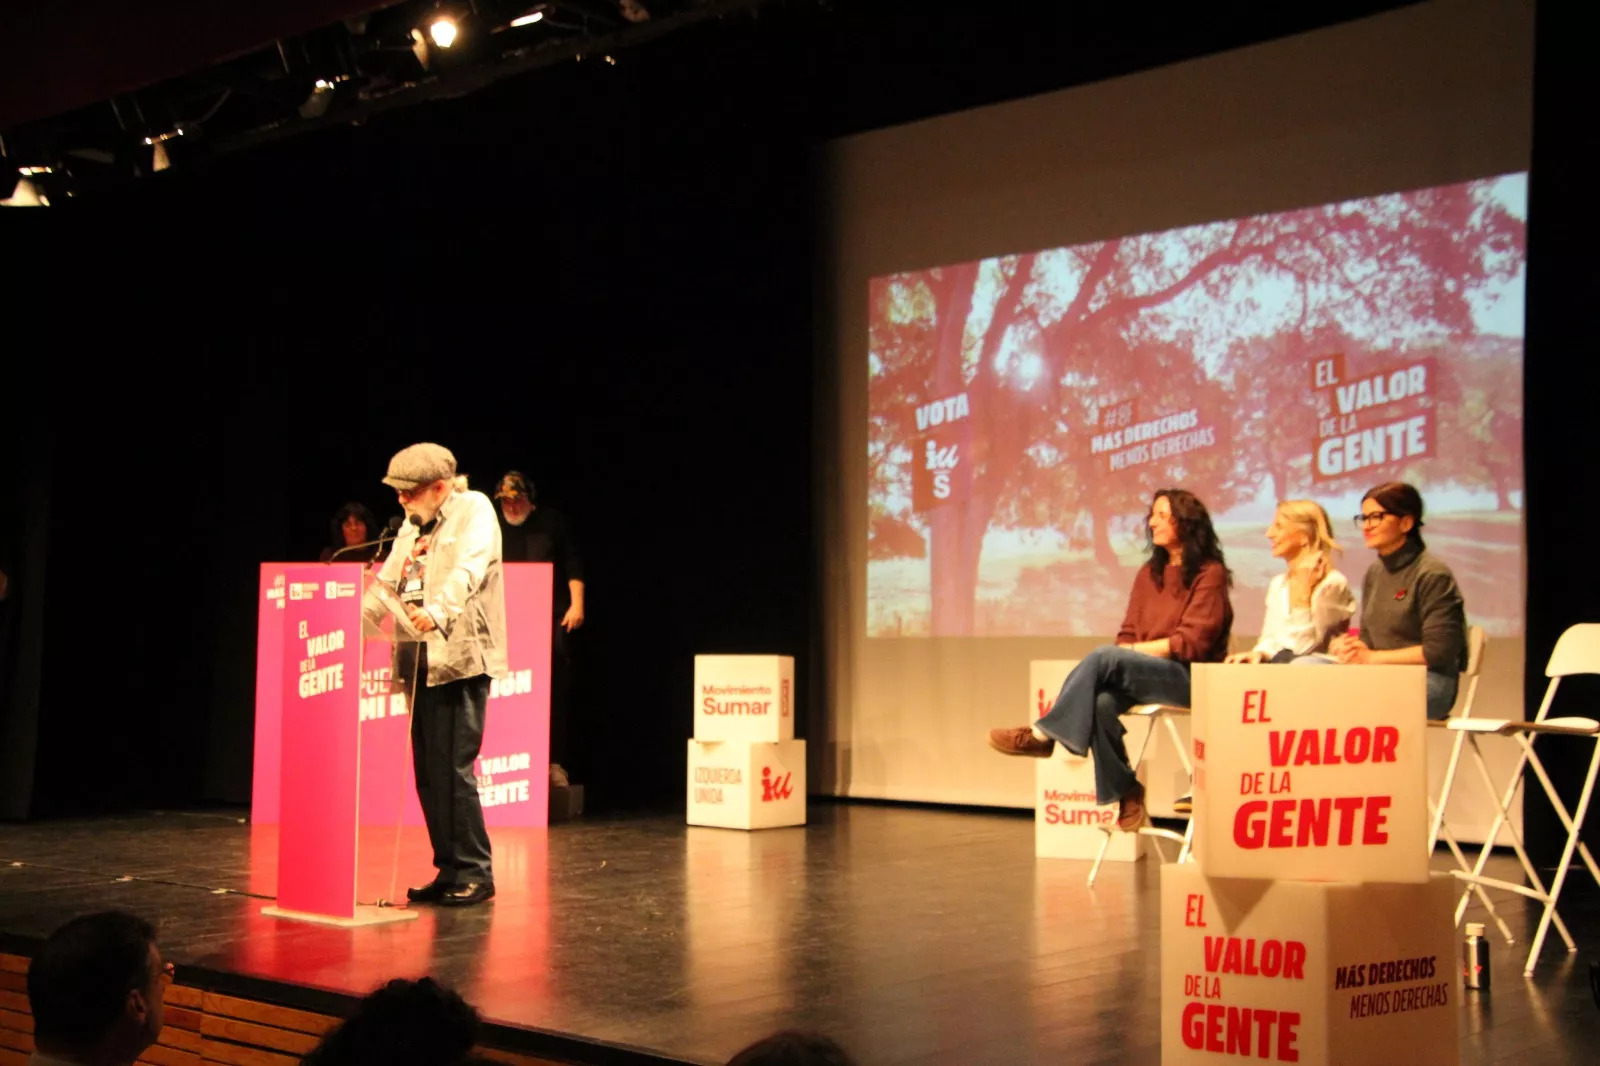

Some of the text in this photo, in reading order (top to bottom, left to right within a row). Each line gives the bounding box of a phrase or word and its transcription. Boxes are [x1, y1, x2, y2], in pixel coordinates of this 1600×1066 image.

[1315, 359, 1338, 388] EL
[1336, 364, 1426, 415] VALOR
[915, 392, 969, 430] VOTA
[1123, 408, 1198, 445] DERECHOS
[1319, 413, 1357, 438] DE LA
[1317, 415, 1426, 476] GENTE
[299, 620, 309, 639] EL
[307, 628, 345, 658] VALOR
[299, 662, 344, 699] GENTE
[702, 685, 772, 695] Movimiento
[702, 697, 772, 715] Sumar
[1241, 690, 1272, 724] EL
[480, 752, 531, 775] VALOR
[1268, 726, 1399, 767] VALOR
[1239, 771, 1292, 795] DE LA
[1232, 796, 1392, 850] GENTE
[1184, 894, 1207, 928] EL
[1203, 936, 1307, 980] VALOR
[1335, 955, 1437, 990] MÁS DERECHOS
[1184, 974, 1221, 1000] DE LA
[1349, 983, 1449, 1019] MENOS DERECHAS
[1181, 1002, 1301, 1063] GENTE
